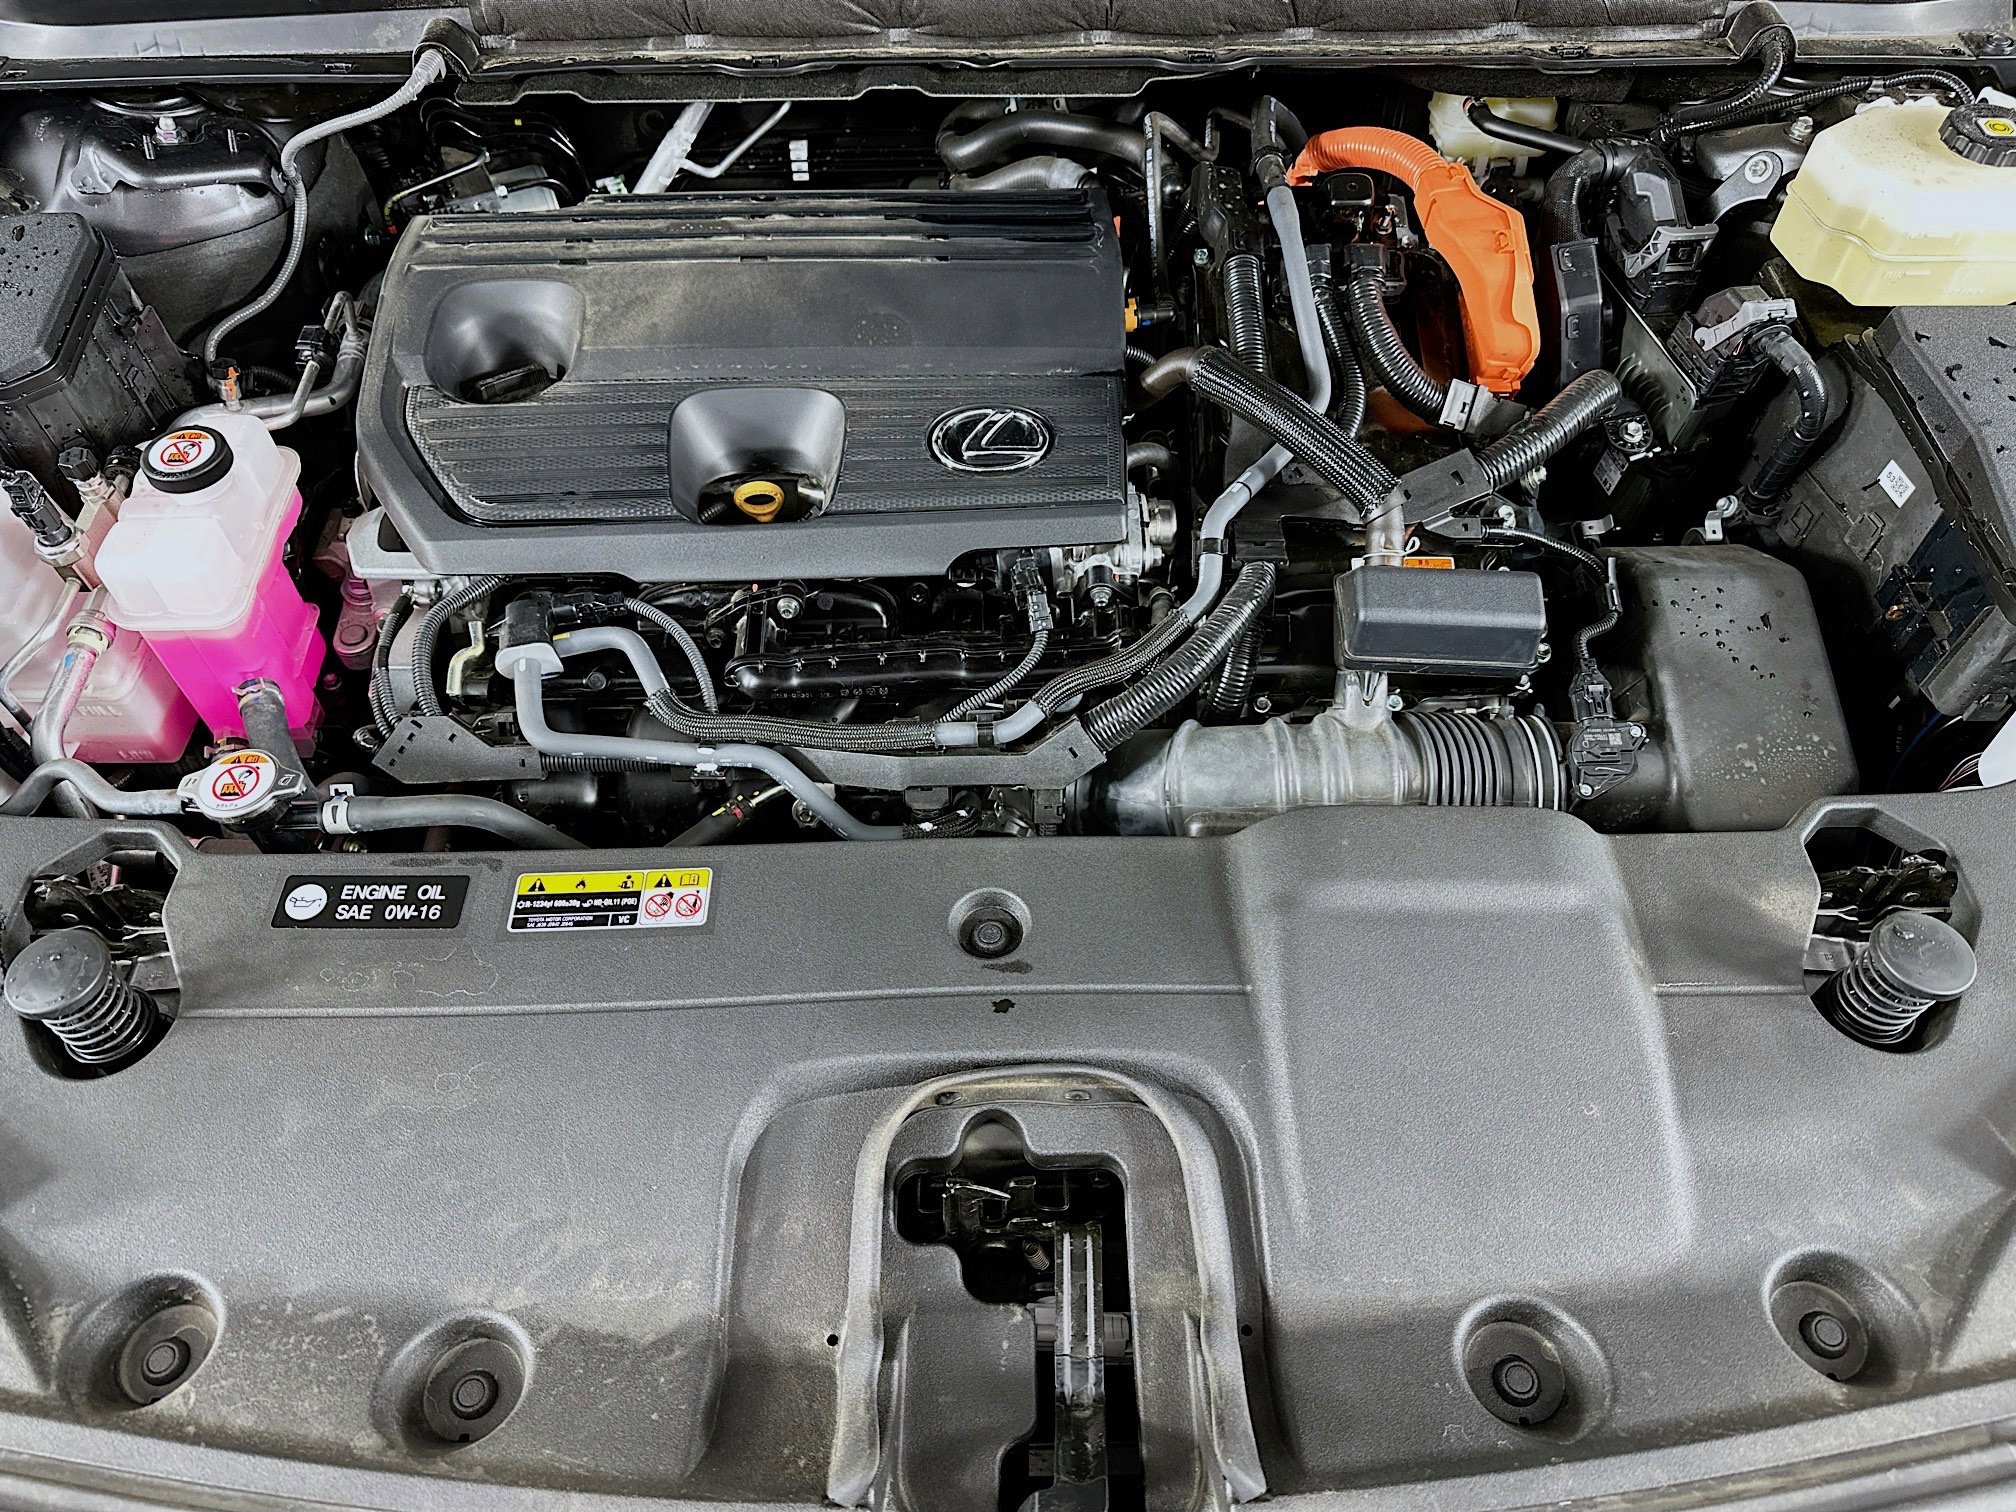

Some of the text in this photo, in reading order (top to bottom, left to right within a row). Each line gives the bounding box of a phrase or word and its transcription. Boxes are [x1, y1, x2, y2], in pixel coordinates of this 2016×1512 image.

[340, 884, 446, 900] ENGINE OIL
[334, 904, 442, 920] SAE 0W-16
[618, 915, 630, 924] VC
